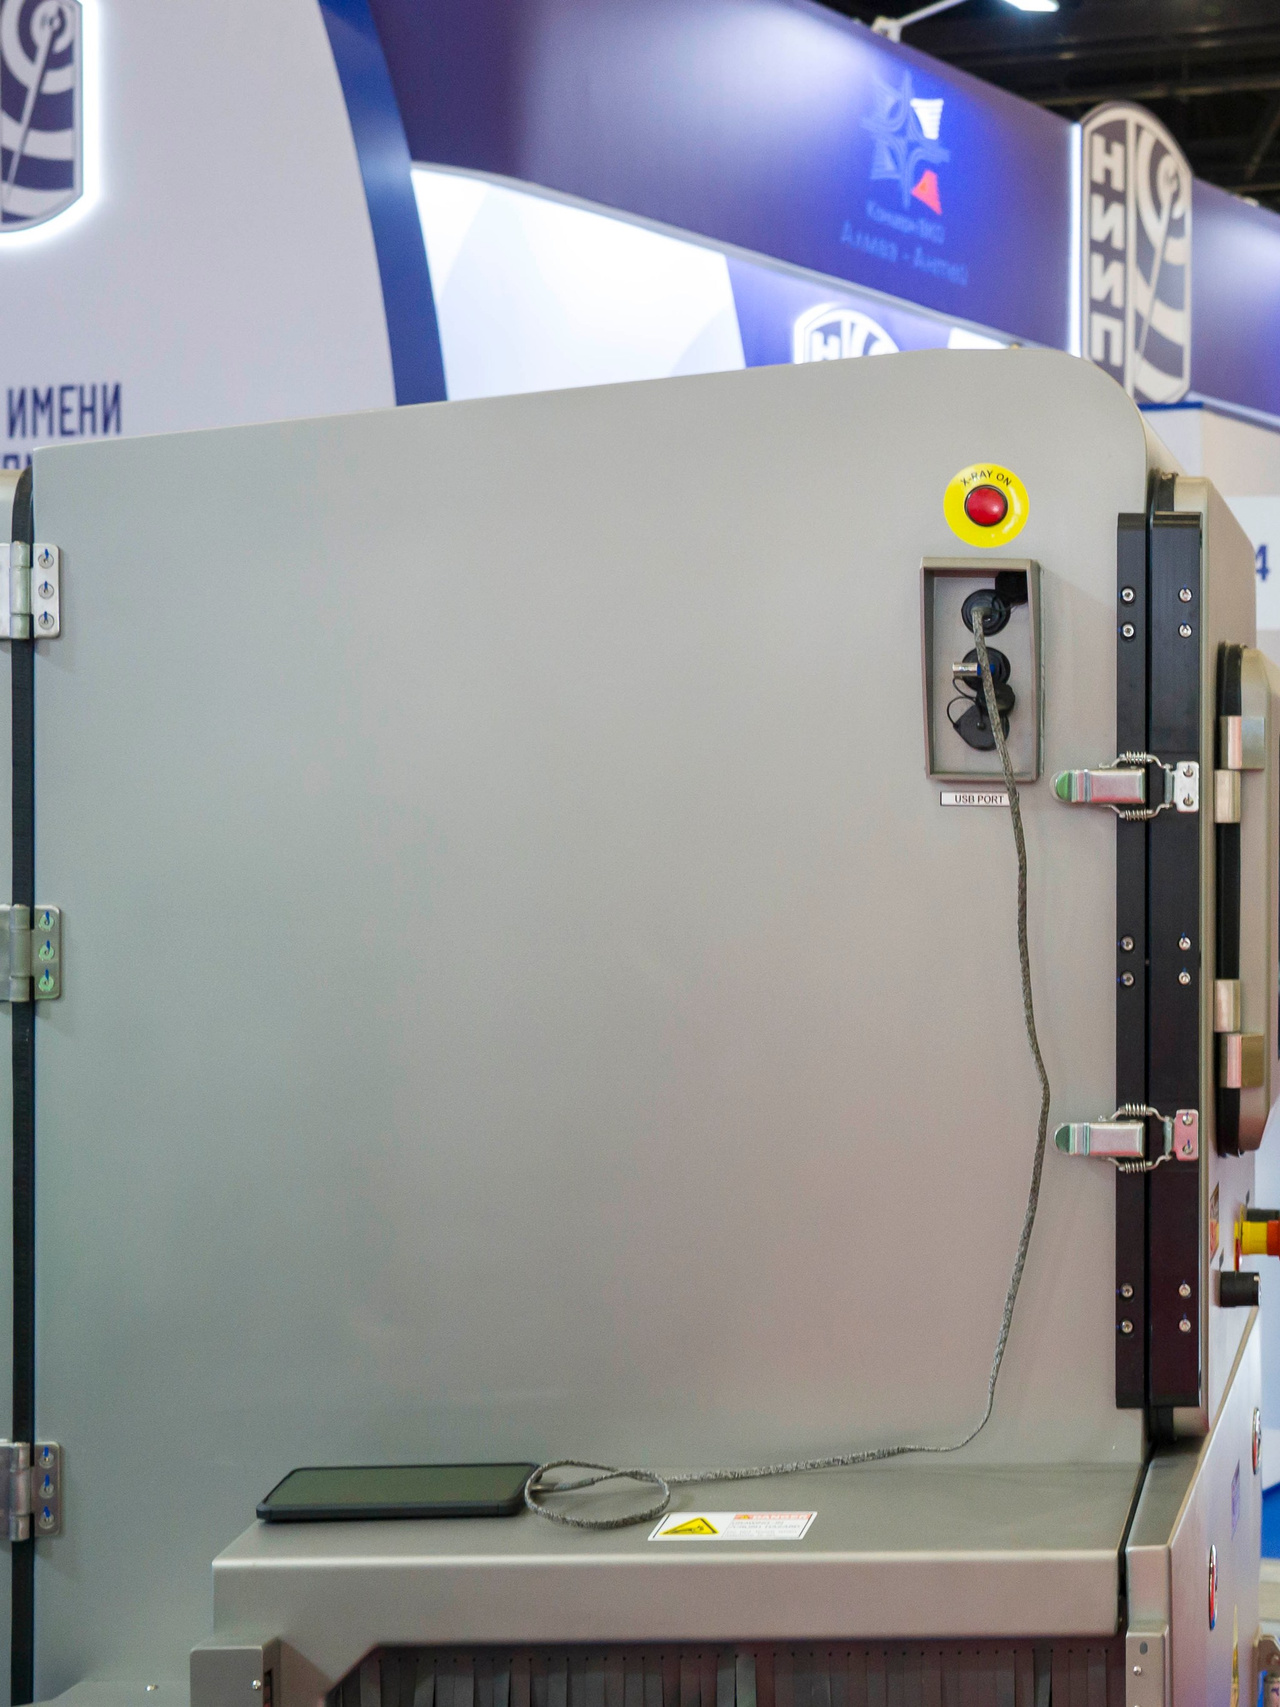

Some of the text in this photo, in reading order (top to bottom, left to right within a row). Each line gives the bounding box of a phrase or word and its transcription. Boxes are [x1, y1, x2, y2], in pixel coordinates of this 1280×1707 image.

[7, 382, 122, 439] ИМЕНИ
[960, 469, 1012, 487] X-RAY ON
[954, 794, 1004, 805] USB PORT
